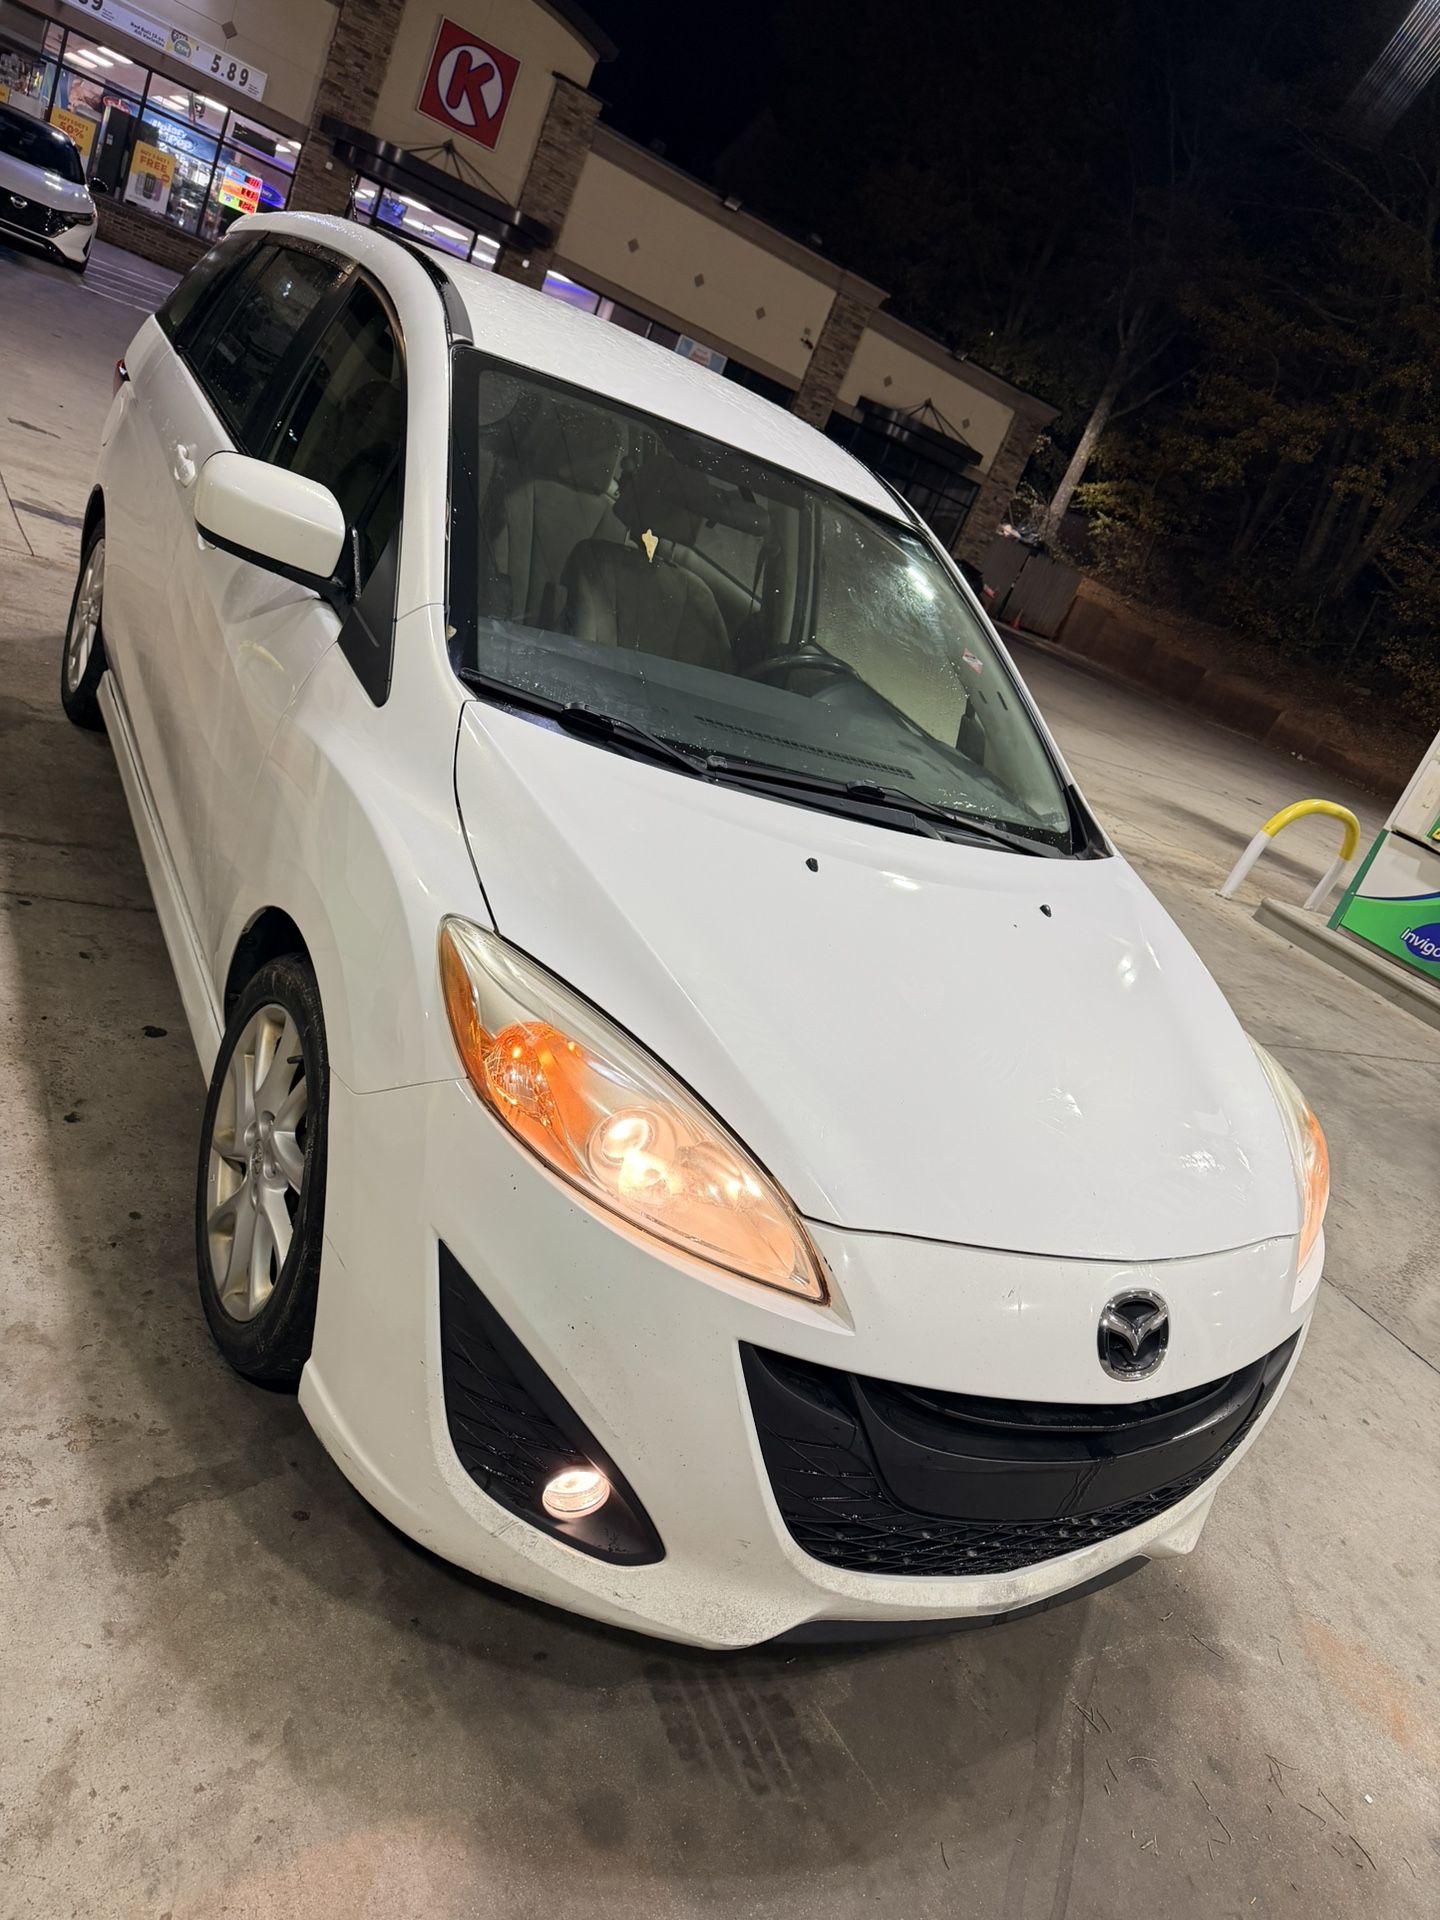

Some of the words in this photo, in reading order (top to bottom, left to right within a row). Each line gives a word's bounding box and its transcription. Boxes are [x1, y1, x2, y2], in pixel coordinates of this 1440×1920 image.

[211, 54, 249, 87] 5.89
[446, 50, 495, 126] K
[60, 121, 84, 138] 50%
[140, 155, 168, 173] FREE
